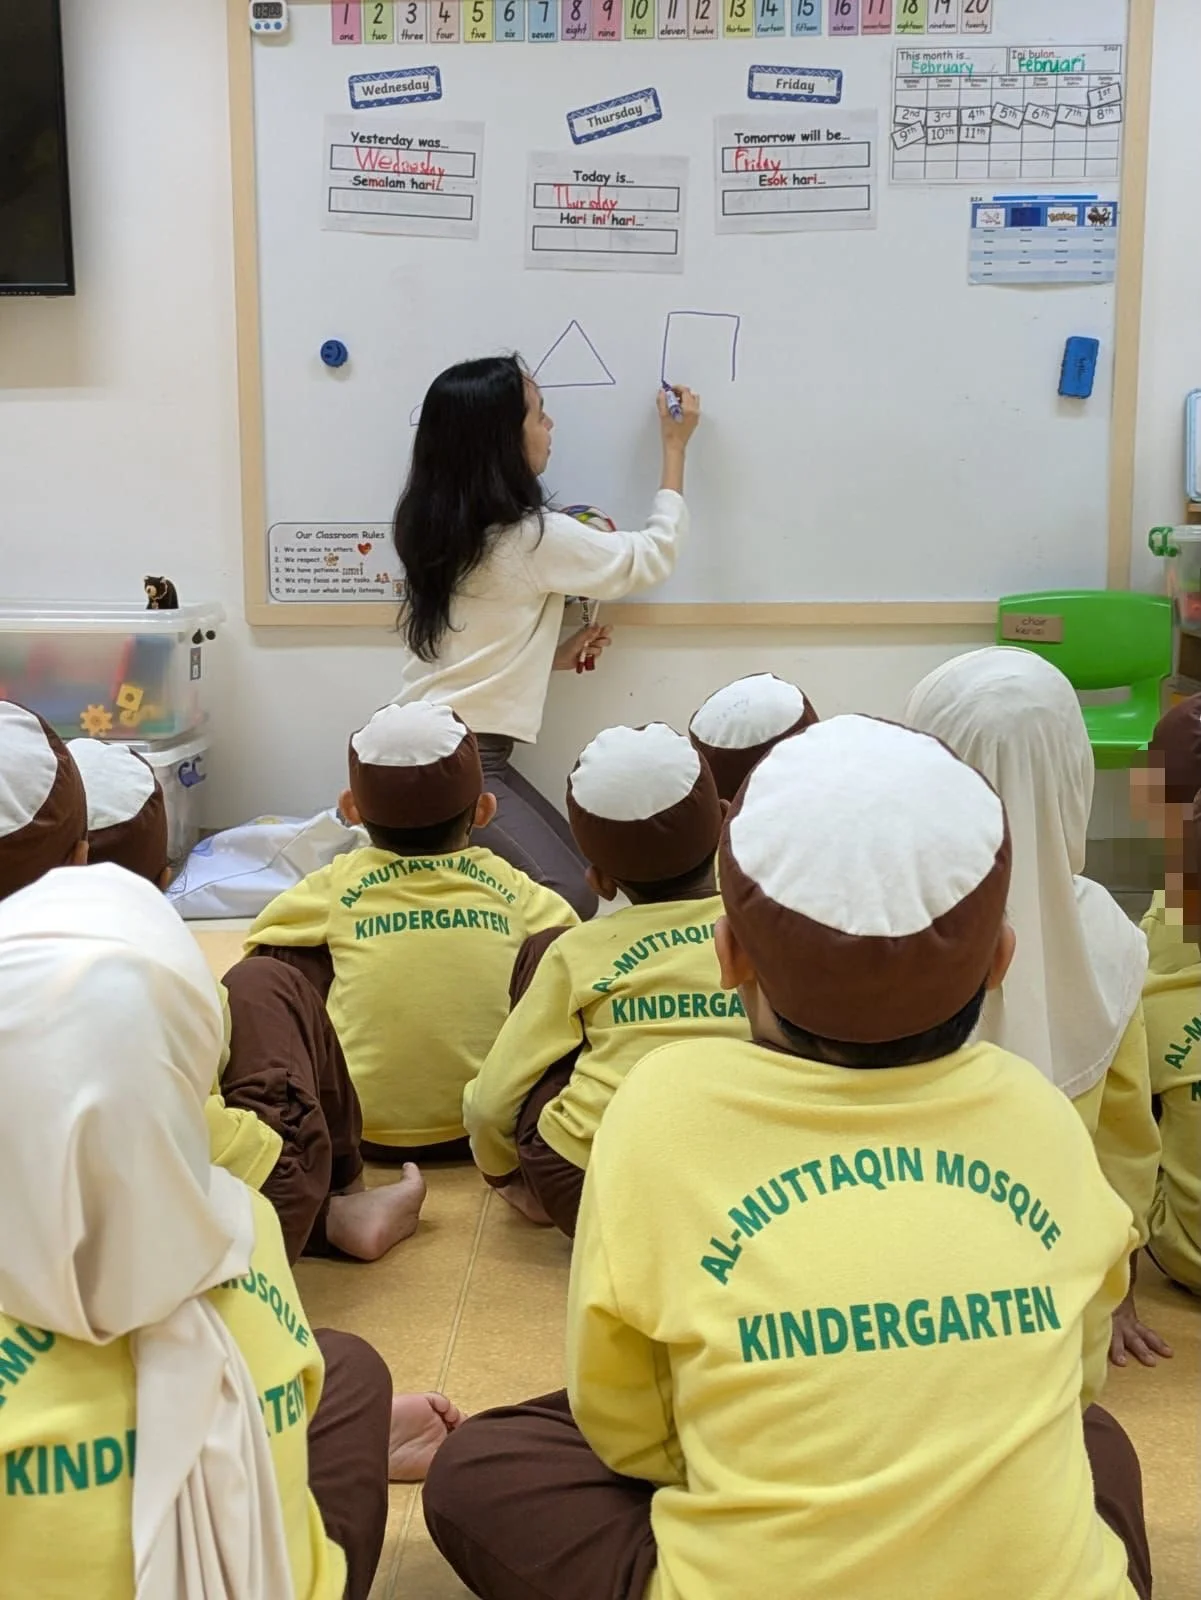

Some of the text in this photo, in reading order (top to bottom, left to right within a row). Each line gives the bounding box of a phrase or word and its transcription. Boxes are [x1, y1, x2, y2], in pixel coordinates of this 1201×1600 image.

[344, 3, 349, 25] 1
[373, 2, 384, 24] 2
[405, 2, 417, 24] 3
[439, 1, 450, 23] 4
[472, 0, 485, 23] 5
[504, 0, 515, 22] 6
[538, 0, 549, 22] 7
[570, 0, 581, 21] 8
[602, 0, 612, 20] 9
[630, 0, 648, 19] 10
[667, 0, 677, 19] 11
[695, 0, 710, 20] 12
[730, 0, 746, 19] 13
[761, 0, 778, 17] 14
[797, 0, 814, 16] 15
[834, 0, 851, 16] 16
[903, 0, 918, 14] 18
[934, 0, 950, 14] 19
[964, 0, 986, 14] 20
[340, 33, 354, 41] one
[372, 32, 387, 40] two
[401, 30, 424, 40] three
[436, 28, 454, 40] four
[471, 27, 486, 39] five
[504, 30, 516, 38] six
[532, 32, 555, 40] seven
[565, 26, 587, 40] eight
[598, 29, 615, 38] nine
[632, 27, 647, 36] ten
[660, 25, 686, 36] eleven
[900, 51, 920, 60] This
[922, 50, 952, 60] month
[1018, 53, 1086, 72] Februari
[912, 61, 974, 77] February
[362, 78, 430, 96] Wednesday
[776, 78, 816, 94] Friday
[1097, 88, 1111, 101] 1st
[587, 106, 643, 128] Thursday
[902, 105, 1115, 122] 2nd 3rd 4th 5th 6th 7th 8th
[351, 132, 414, 152] Yesterday
[734, 132, 796, 144] Tomorrow
[801, 131, 820, 142] will
[900, 126, 986, 142] 9th 10th 11th
[734, 146, 782, 176] Friday
[352, 175, 406, 190] Semalam
[573, 170, 611, 186] Today
[759, 174, 788, 187] Esok
[560, 212, 587, 225] Hari
[592, 214, 606, 226] ini
[296, 530, 385, 540] Our Classroom Rules
[457, 856, 516, 904] MOSQUE
[355, 909, 510, 940] KINDERGARTEN
[612, 992, 746, 1024] KINDERGA
[700, 1147, 1061, 1285] AL-MUTTAQIN MOSQUE
[738, 1286, 1061, 1363] KINDERGARTEN
